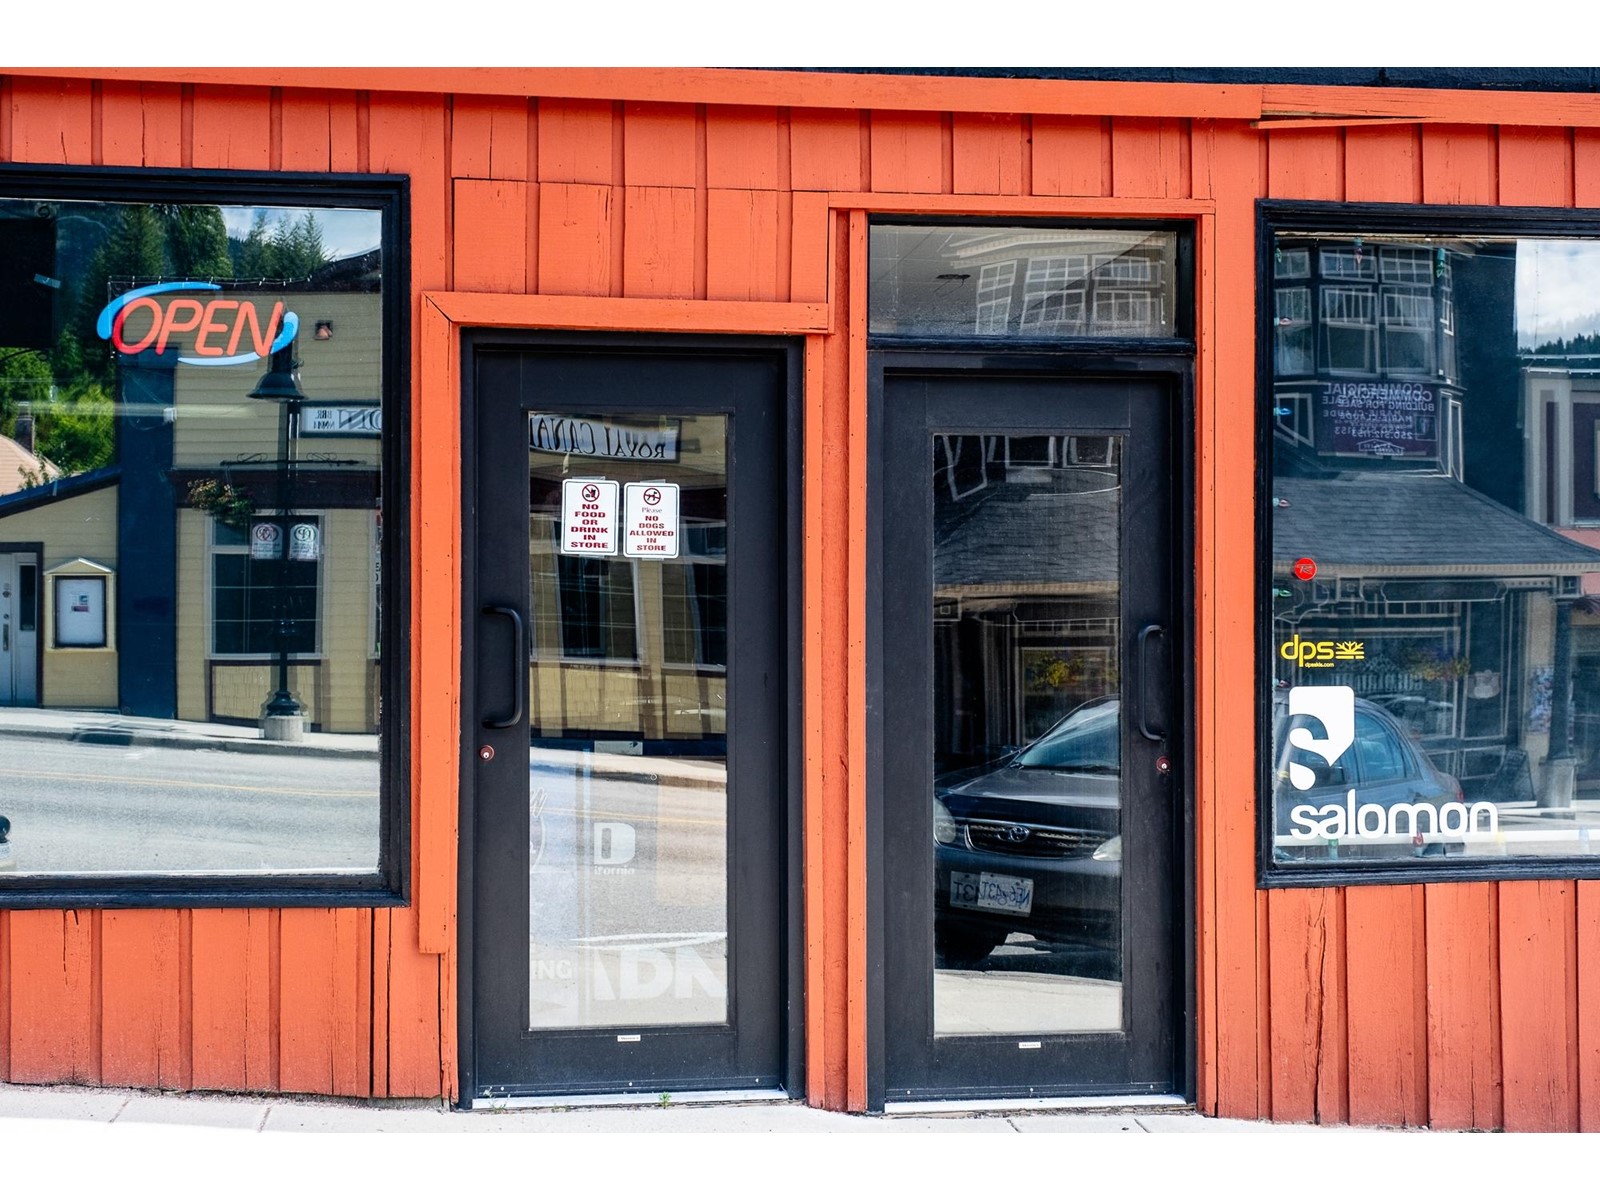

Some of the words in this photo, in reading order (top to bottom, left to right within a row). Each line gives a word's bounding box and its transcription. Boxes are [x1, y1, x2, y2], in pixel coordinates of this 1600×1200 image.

[112, 297, 284, 357] OPEN
[1280, 634, 1335, 668] dps
[1290, 788, 1499, 840] salomon
